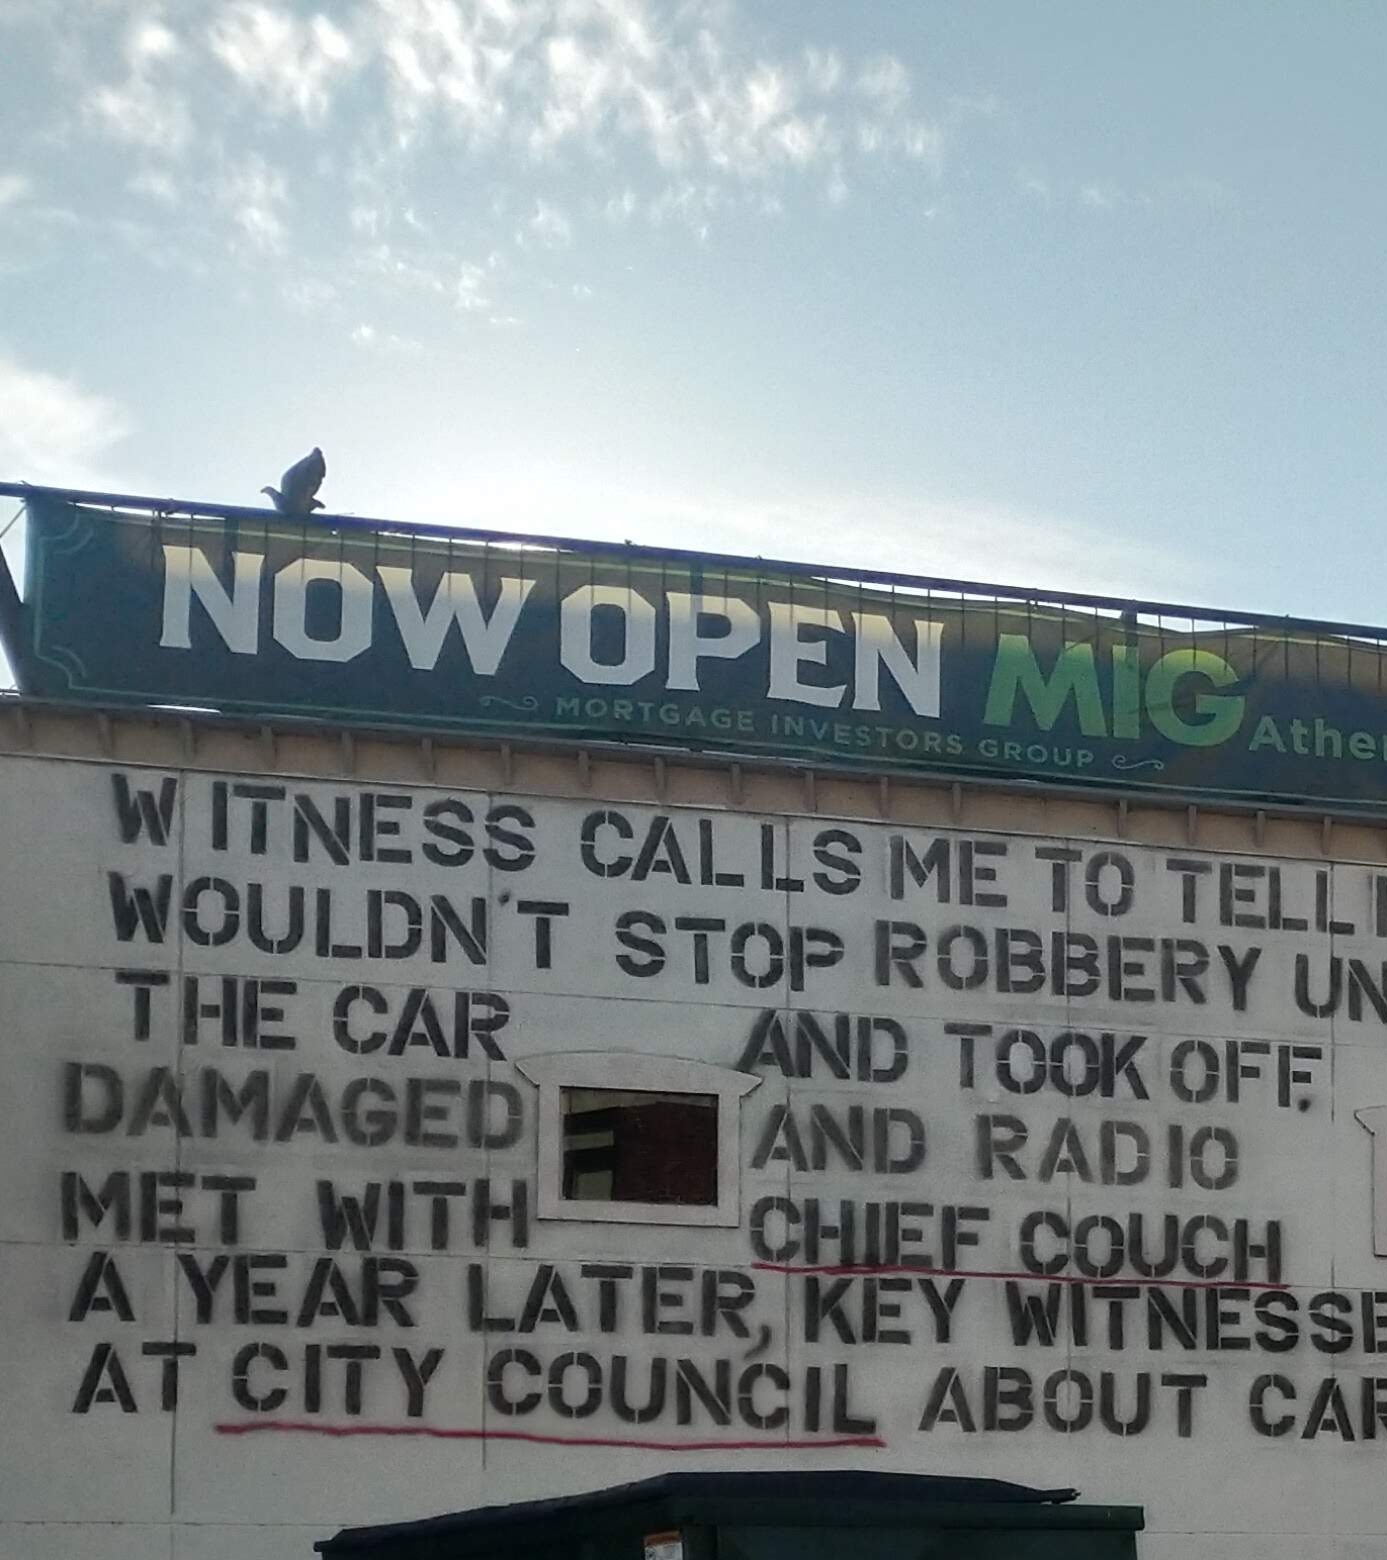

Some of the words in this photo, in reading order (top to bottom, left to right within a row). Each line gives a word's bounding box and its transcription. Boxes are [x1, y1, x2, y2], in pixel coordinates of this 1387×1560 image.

[159, 545, 536, 675] NOW
[559, 584, 944, 717] OPEN
[984, 634, 1246, 746] MIG
[556, 697, 755, 730] MORTGAGE
[771, 714, 963, 755] INVESTORS
[978, 738, 1095, 769] GROUP
[111, 773, 536, 871] WITNESS
[580, 809, 862, 895] CALLS
[889, 834, 1007, 907] ME
[1034, 846, 1135, 916] TO
[1166, 858, 1355, 934] TELL
[108, 871, 569, 969] WOULDN'T
[615, 911, 844, 991] STOP
[875, 920, 1262, 1012] ROBBERY
[115, 970, 296, 1049] THE
[332, 985, 510, 1061] CAR
[737, 1009, 908, 1083] AND
[944, 1023, 1150, 1100] TOOK
[1169, 1039, 1321, 1112] OFF.
[63, 1061, 523, 1149] DAMAGED
[752, 1104, 925, 1174] AND
[975, 1115, 1239, 1190] RADIO
[61, 1171, 256, 1244] MET
[317, 1179, 527, 1250] WITH
[750, 1196, 990, 1270] CHIEF
[1020, 1211, 1280, 1282] COUCH
[68, 1251, 135, 1321] A
[178, 1254, 418, 1327] YEAR
[469, 1263, 770, 1358] LATER,
[805, 1276, 965, 1344] KEY
[72, 1342, 196, 1413] AT
[232, 1342, 445, 1416] CITY
[487, 1348, 876, 1434] COUNCIL
[918, 1366, 1207, 1437] ABOUT
